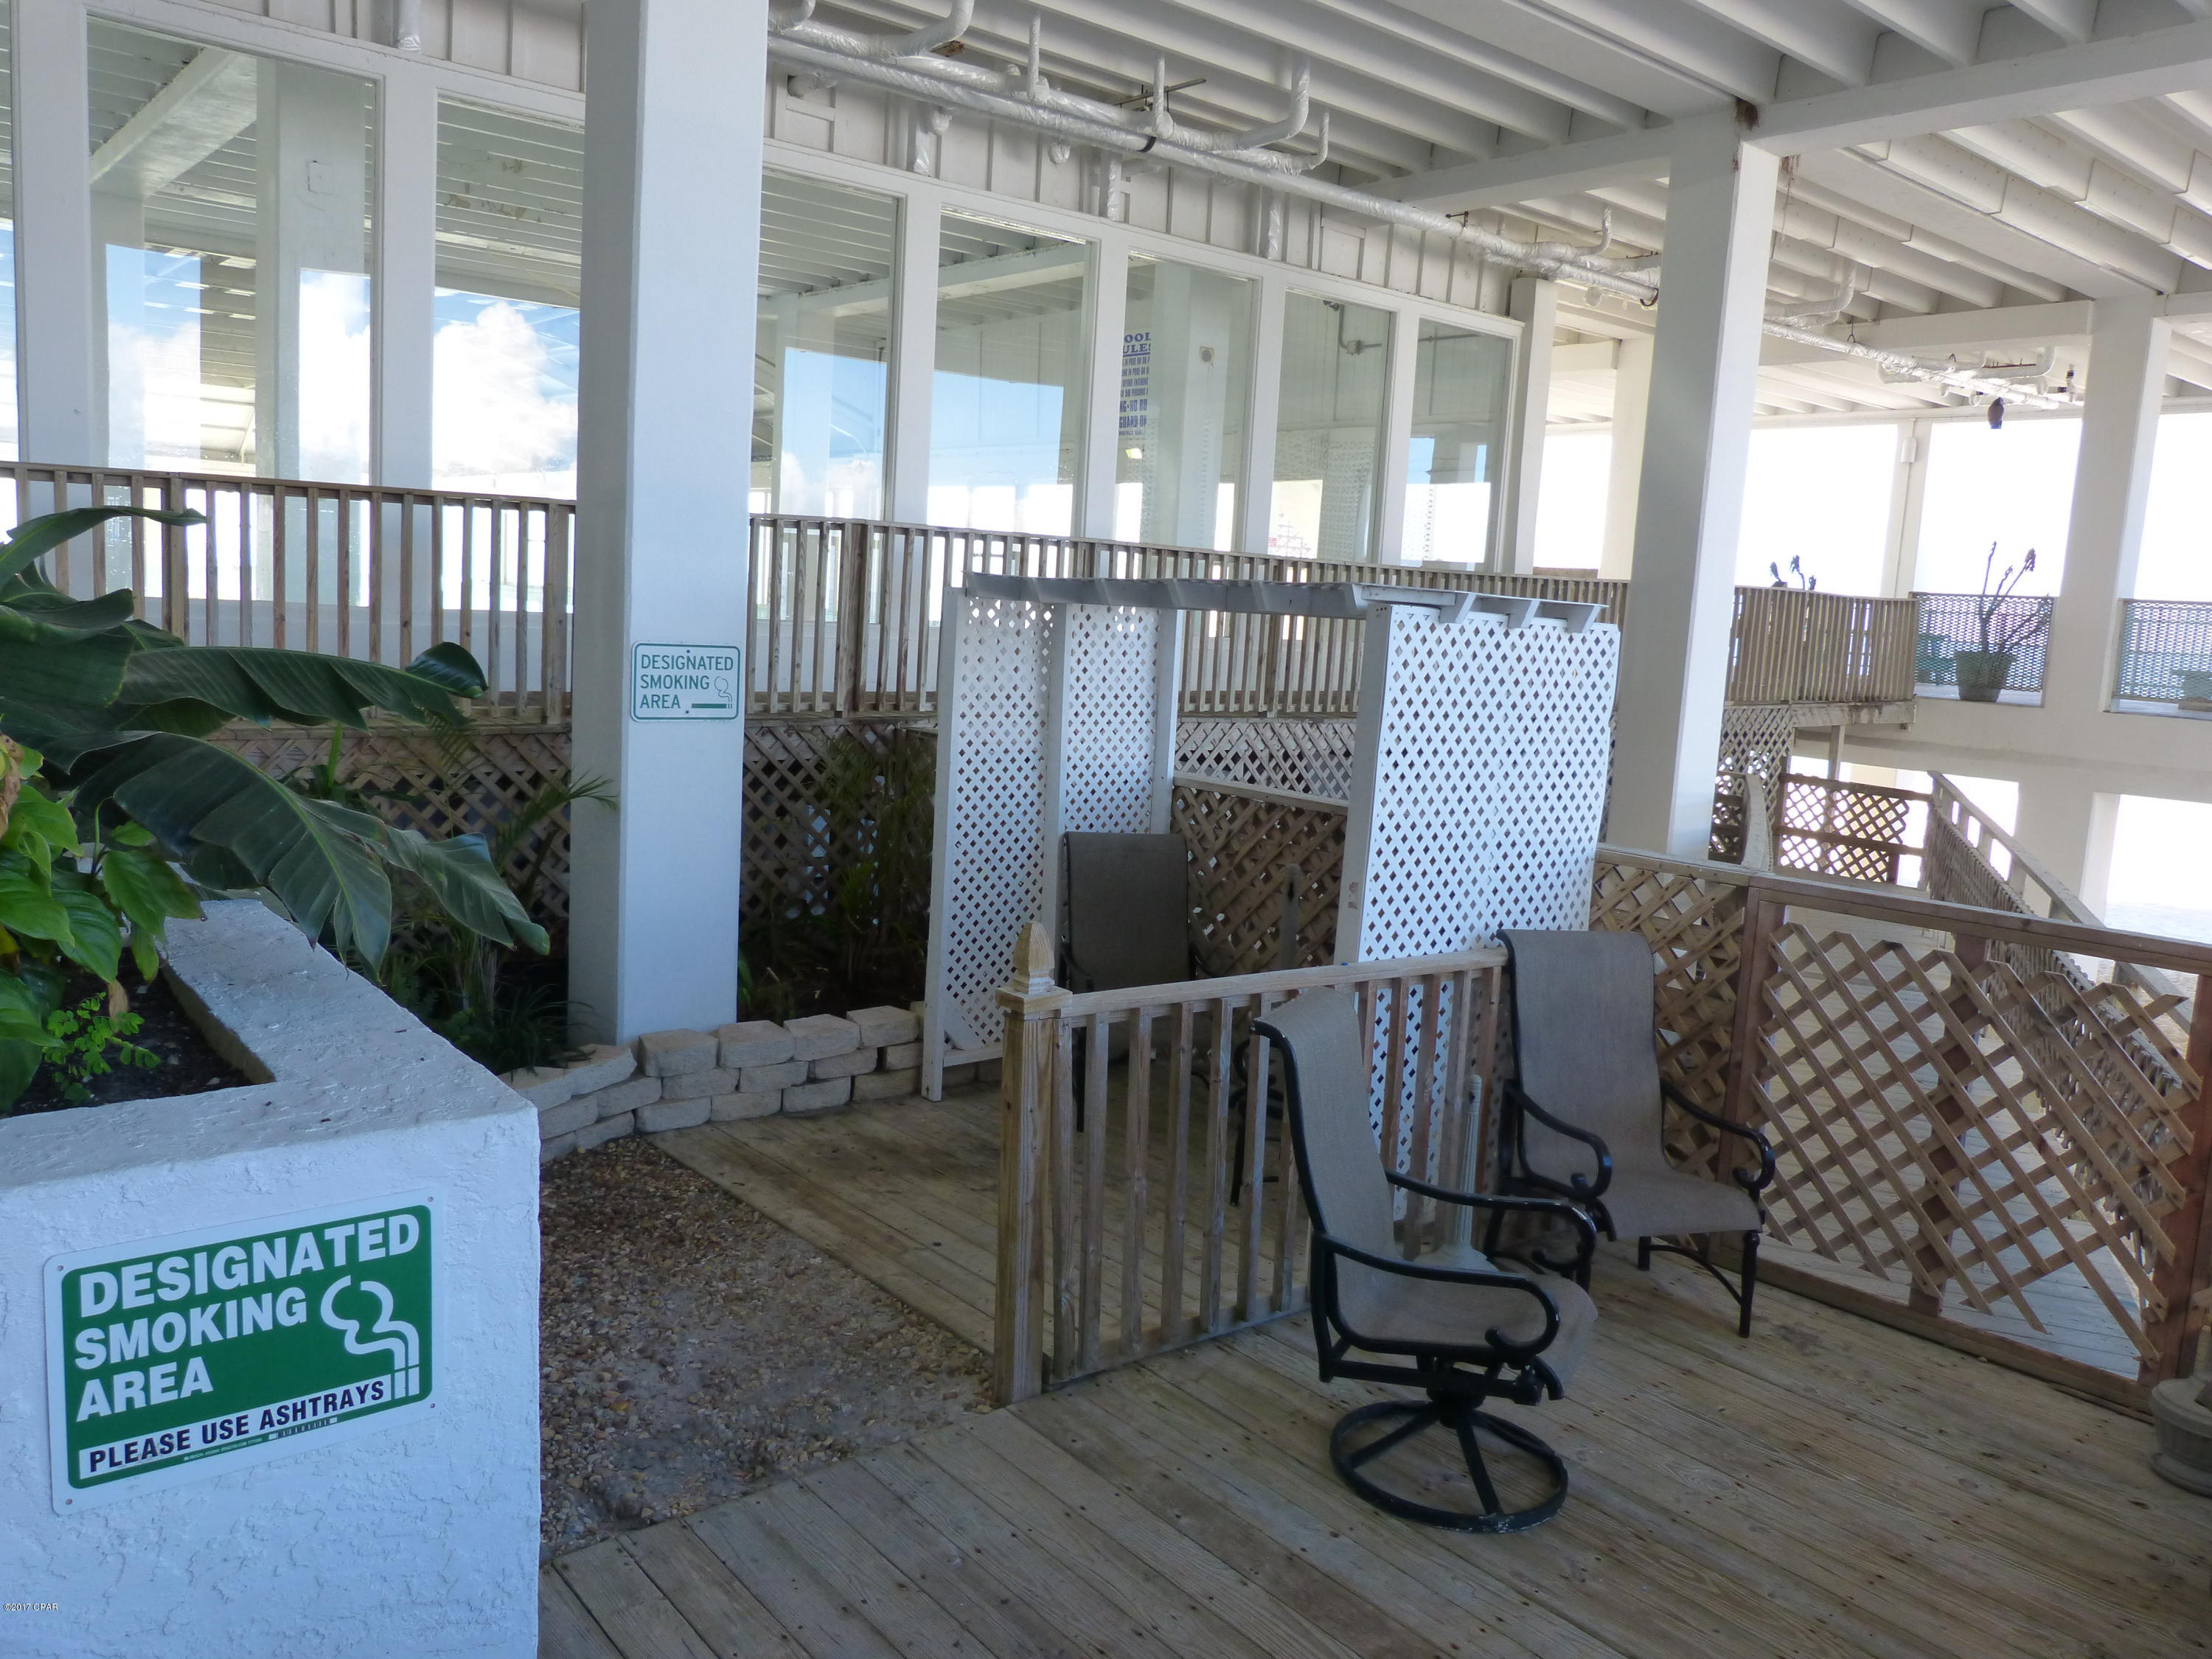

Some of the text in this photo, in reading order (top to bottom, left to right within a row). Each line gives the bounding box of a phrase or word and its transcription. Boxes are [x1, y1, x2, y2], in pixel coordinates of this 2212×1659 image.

[1124, 332, 1151, 343] OOL
[1122, 343, 1151, 354] ULE
[641, 654, 734, 671] DESIGNATED
[640, 674, 709, 690] SMOKING
[640, 694, 681, 709] AREA
[80, 1214, 420, 1318] DESIGNATED
[74, 1287, 307, 1370] SMOKING
[76, 1356, 214, 1422] AREA
[89, 1428, 191, 1473] PLEASE
[202, 1414, 249, 1444] USE
[260, 1380, 384, 1430] ASHTRAYS
